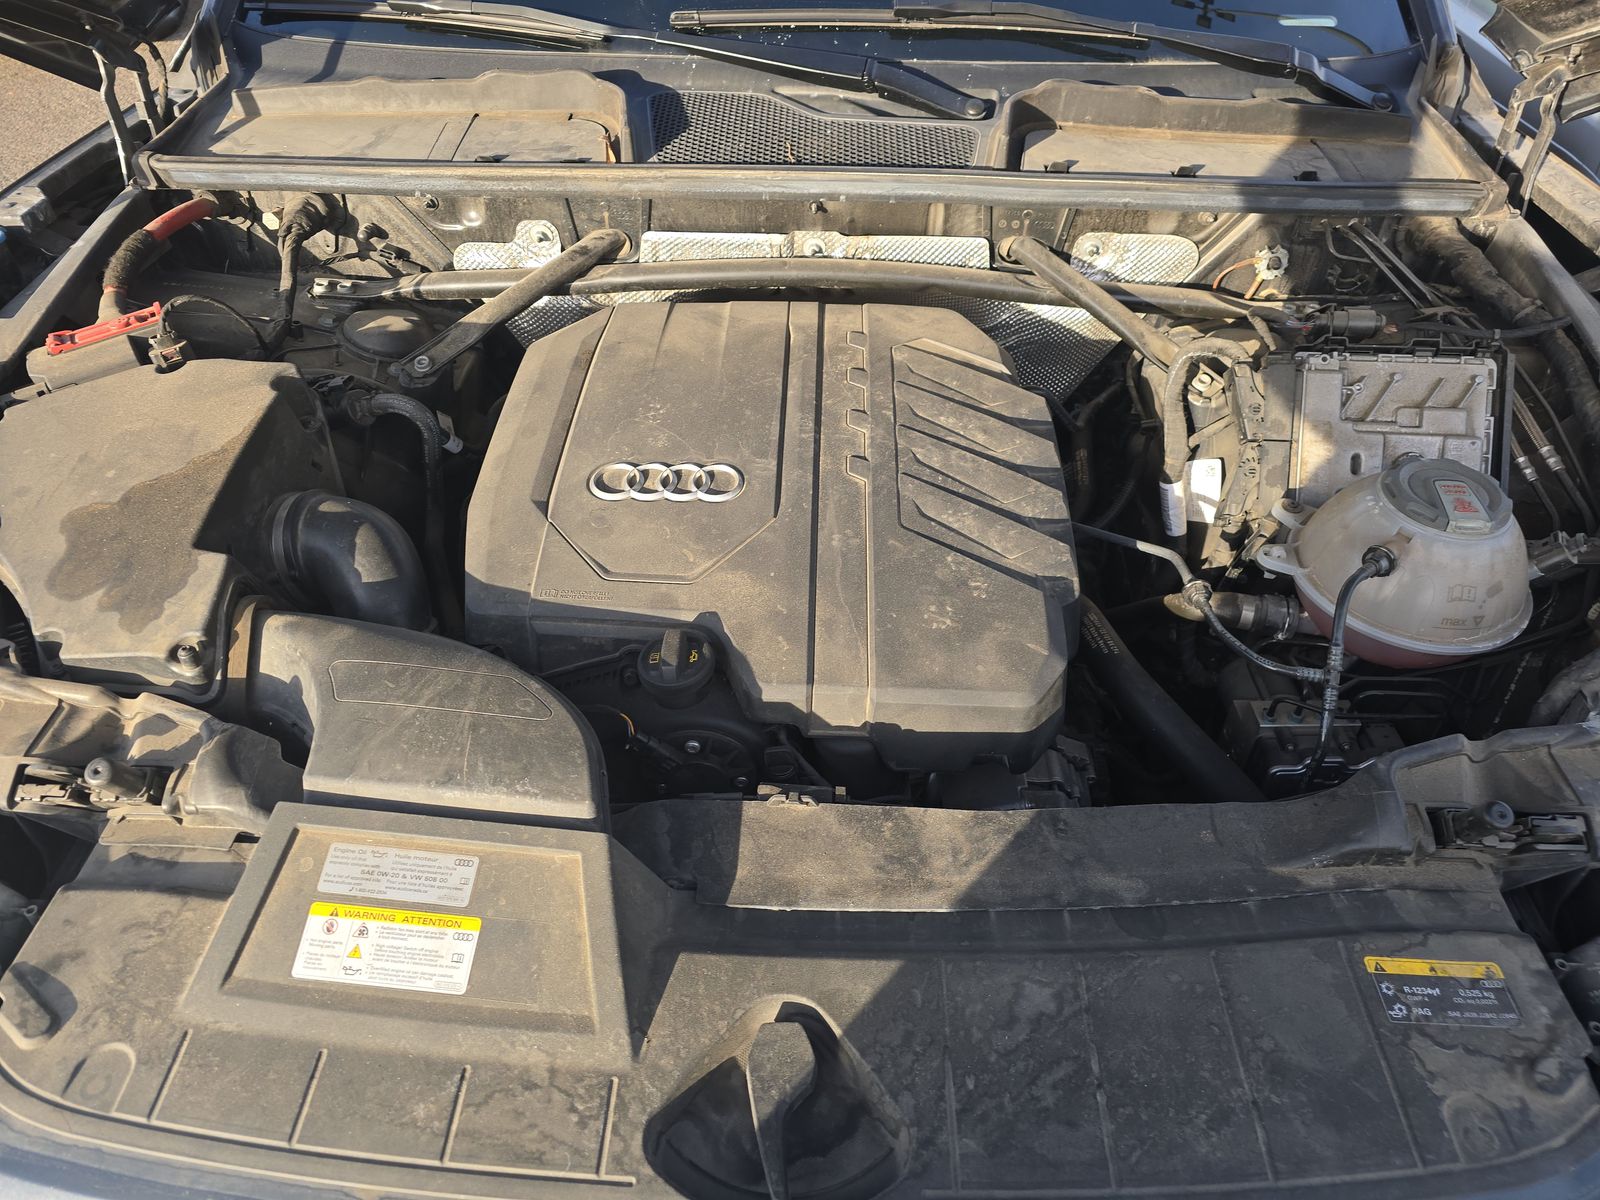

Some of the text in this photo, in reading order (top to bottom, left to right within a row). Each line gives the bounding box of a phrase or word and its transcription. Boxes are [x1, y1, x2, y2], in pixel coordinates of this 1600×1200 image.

[1440, 617, 1468, 626] max
[344, 909, 462, 929] WARNING ATTENTION
